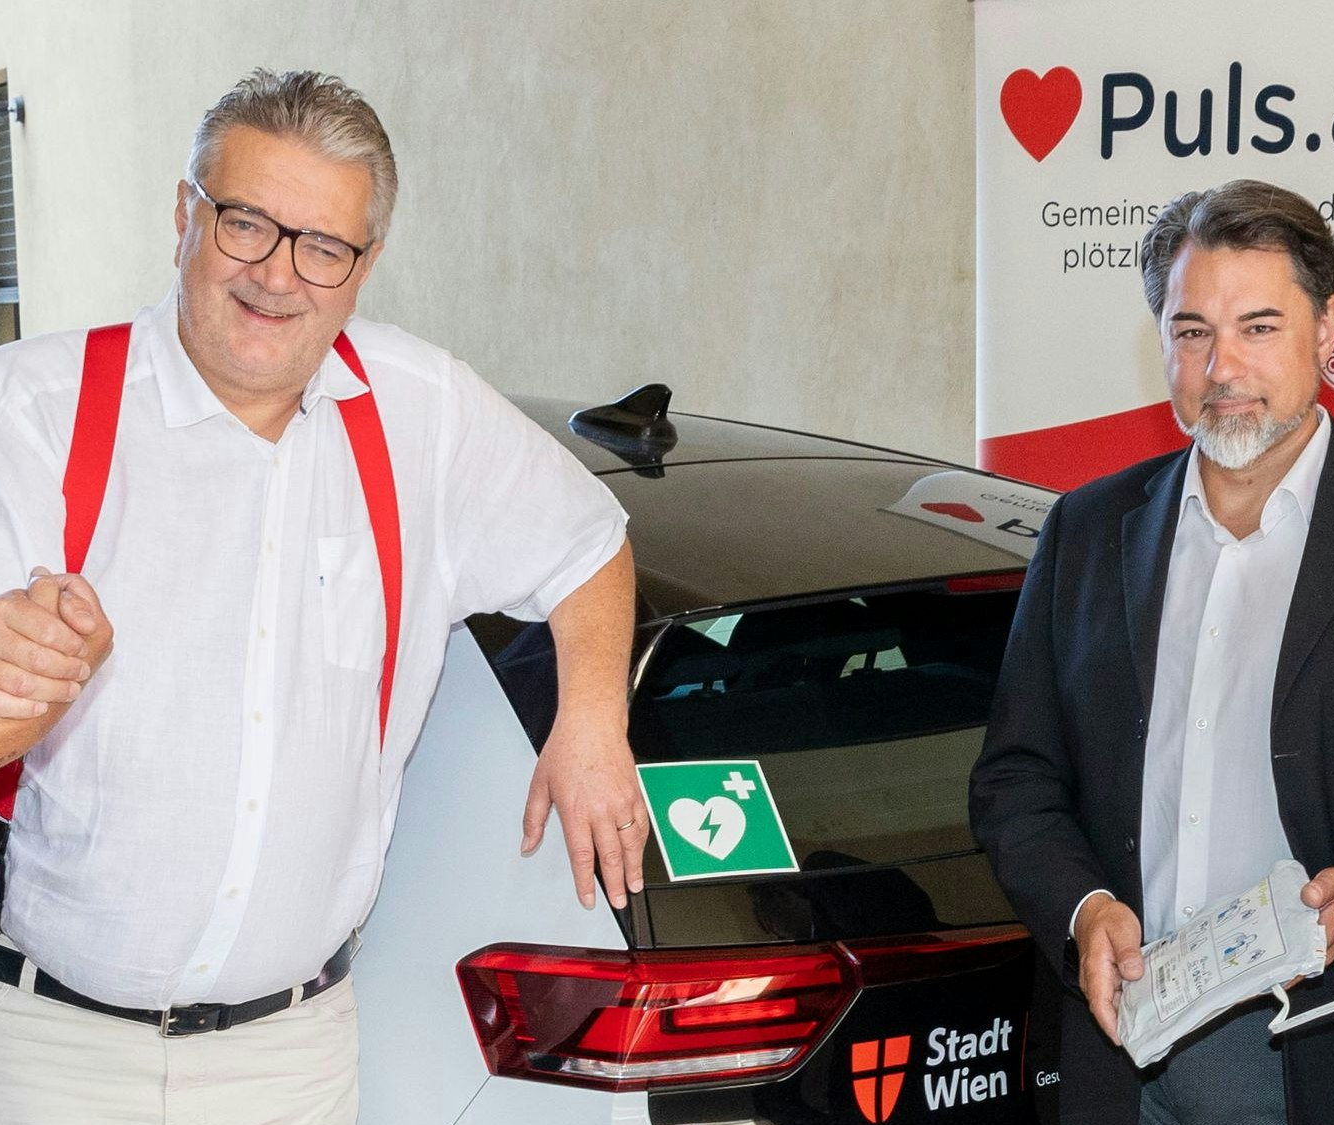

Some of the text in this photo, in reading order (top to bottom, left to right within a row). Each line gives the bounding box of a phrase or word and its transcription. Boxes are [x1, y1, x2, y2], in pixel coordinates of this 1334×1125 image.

[1041, 199, 1169, 228] Gemeins
[1063, 241, 1141, 274] plötzl
[925, 1017, 1013, 1067] Stadt
[923, 1066, 1008, 1111] Wien
